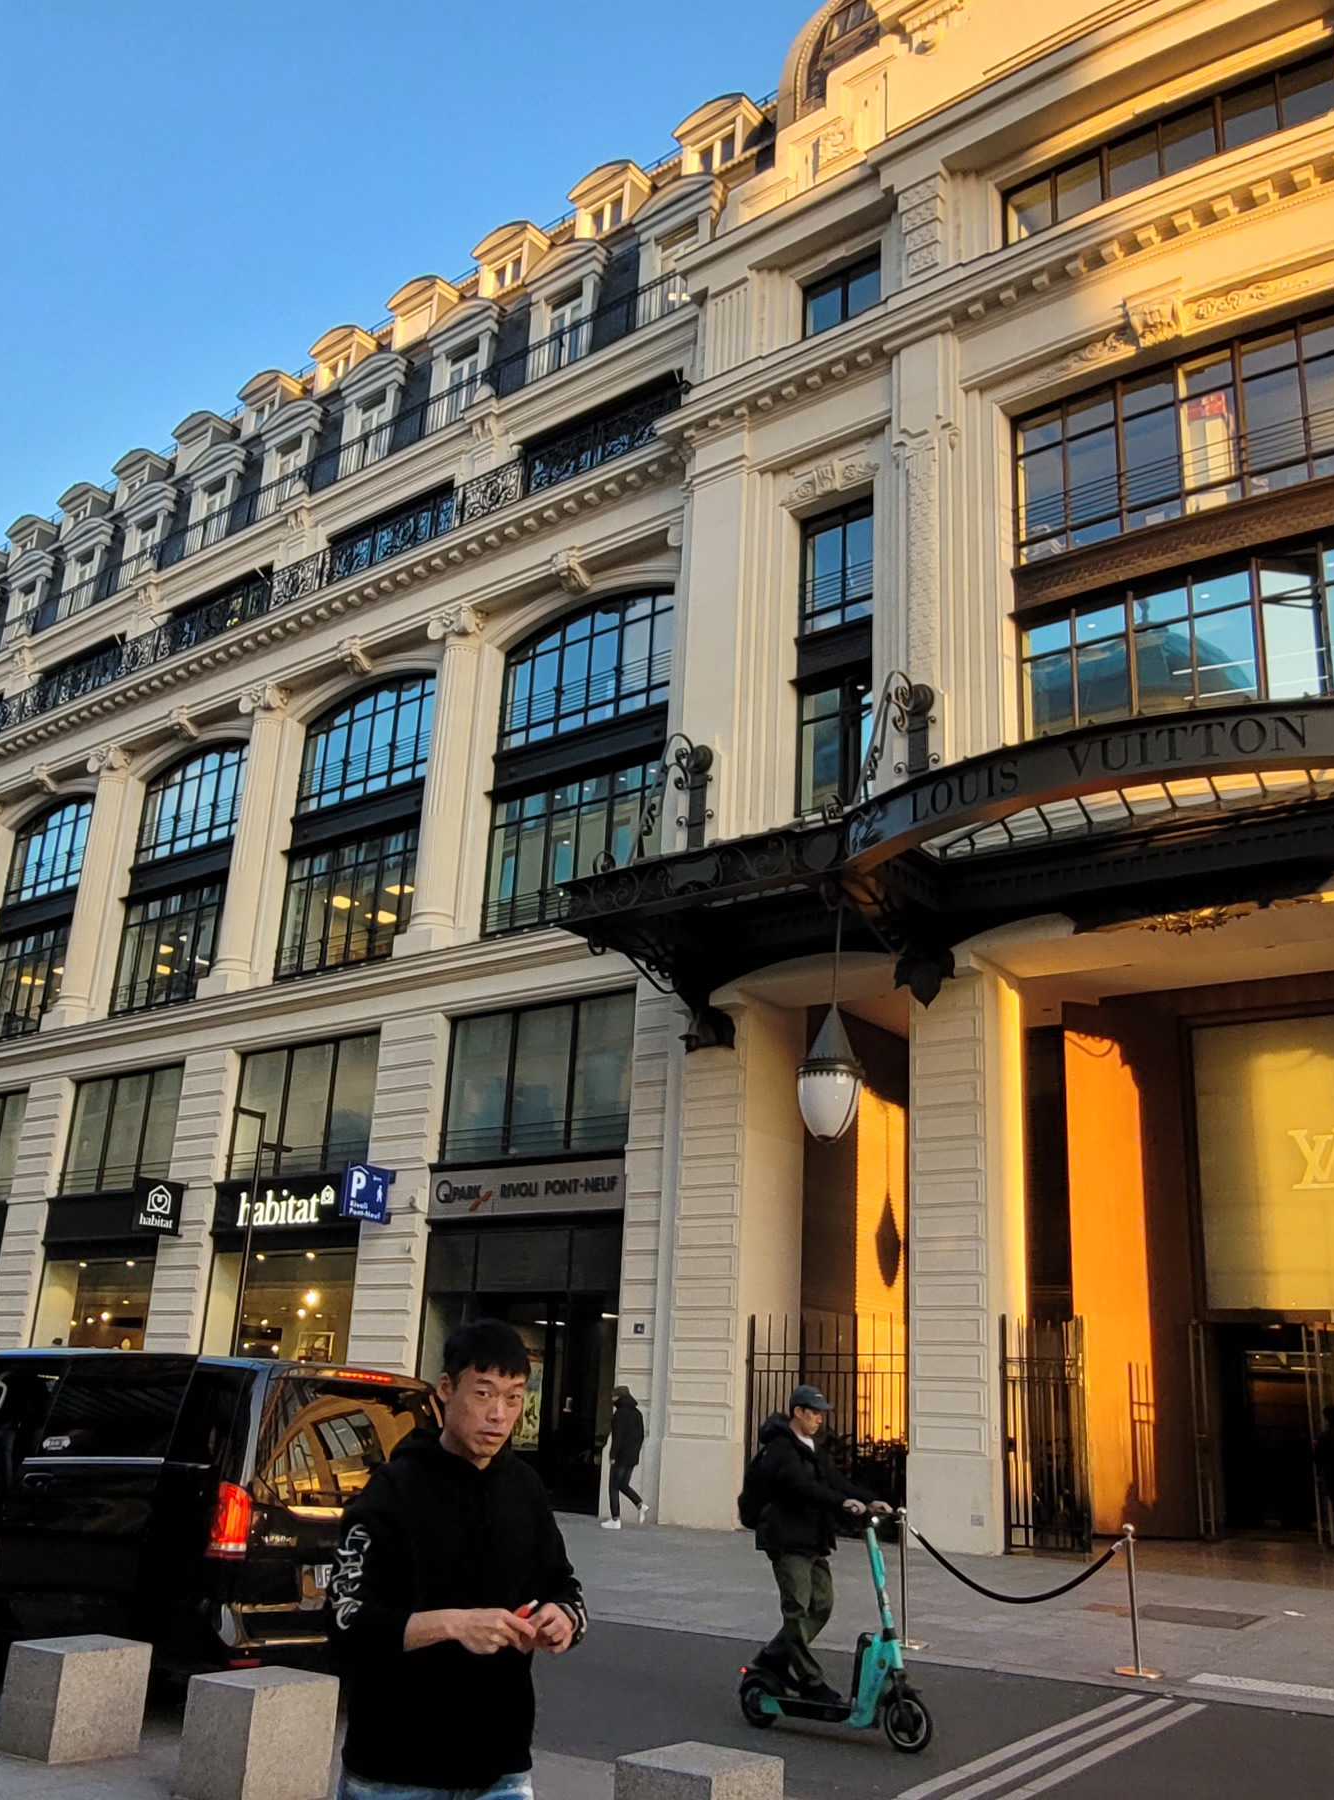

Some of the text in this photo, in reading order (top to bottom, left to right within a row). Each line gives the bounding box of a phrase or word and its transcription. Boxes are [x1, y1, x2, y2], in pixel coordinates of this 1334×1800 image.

[909, 713, 1309, 826] LOUIS VUITTON
[351, 1170, 367, 1199] P
[544, 1175, 618, 1196] PONT-NEUF
[138, 1212, 174, 1230] habitat
[236, 1188, 321, 1228] habitat
